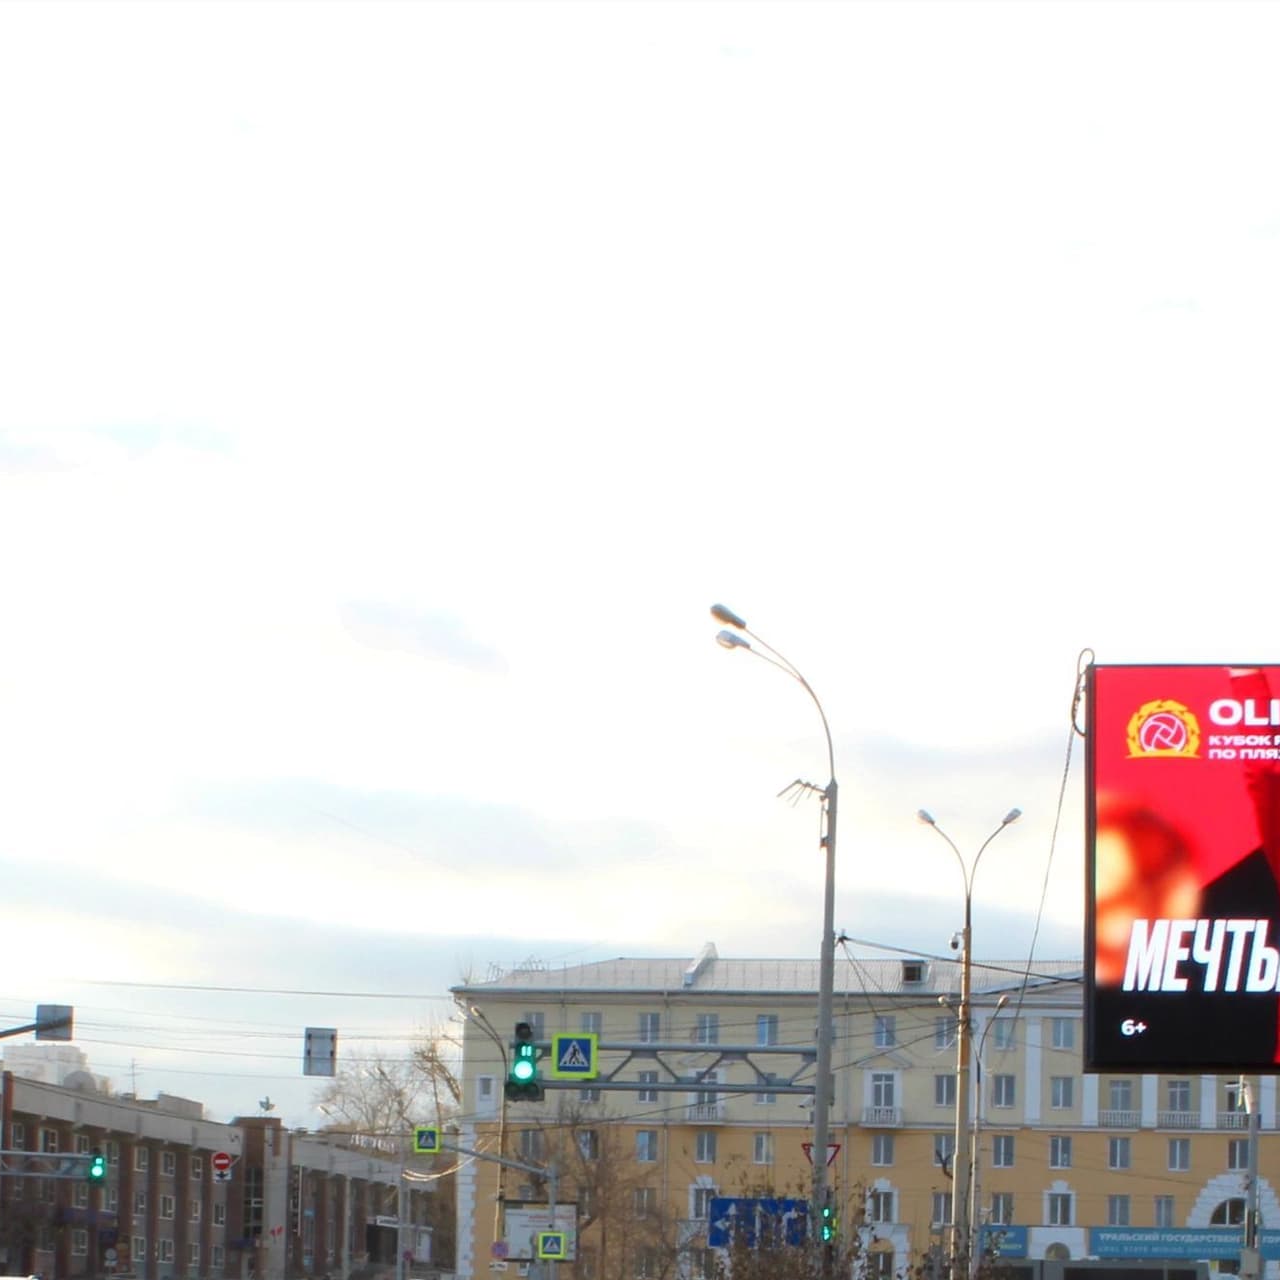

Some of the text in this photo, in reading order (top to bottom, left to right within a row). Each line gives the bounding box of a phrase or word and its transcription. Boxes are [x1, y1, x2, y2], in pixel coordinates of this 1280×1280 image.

[1209, 735, 1271, 746] КУБОК
[1208, 749, 1236, 760] ПО
[1121, 1019, 1147, 1036] 6+
[1099, 1232, 1160, 1241] УРАЛЬСКИЙ
[1161, 1234, 1241, 1243] ГОСУДАРСТВЕН
